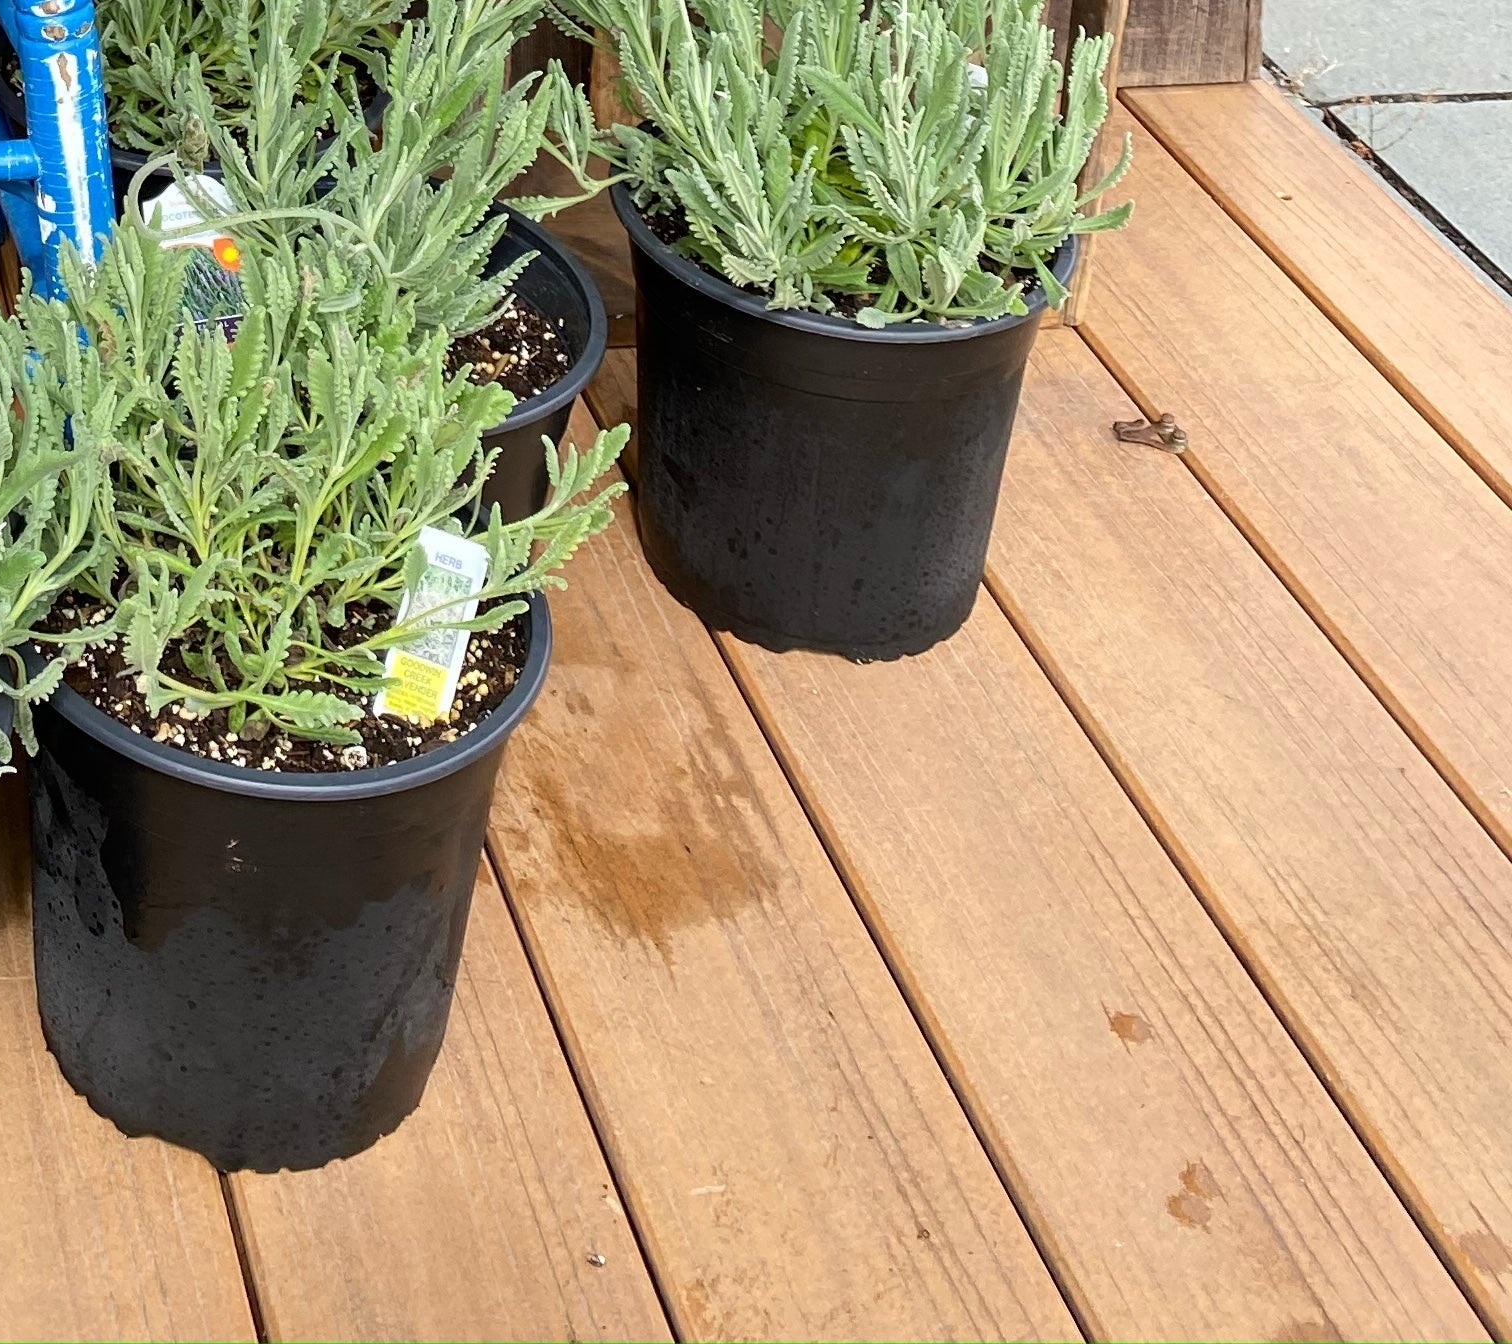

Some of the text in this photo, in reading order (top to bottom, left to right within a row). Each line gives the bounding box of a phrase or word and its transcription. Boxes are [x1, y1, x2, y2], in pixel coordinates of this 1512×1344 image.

[434, 552, 463, 570] HERB
[400, 656, 442, 679] GOODWIN
[403, 669, 433, 686] CREEK
[403, 681, 438, 699] VENDER
